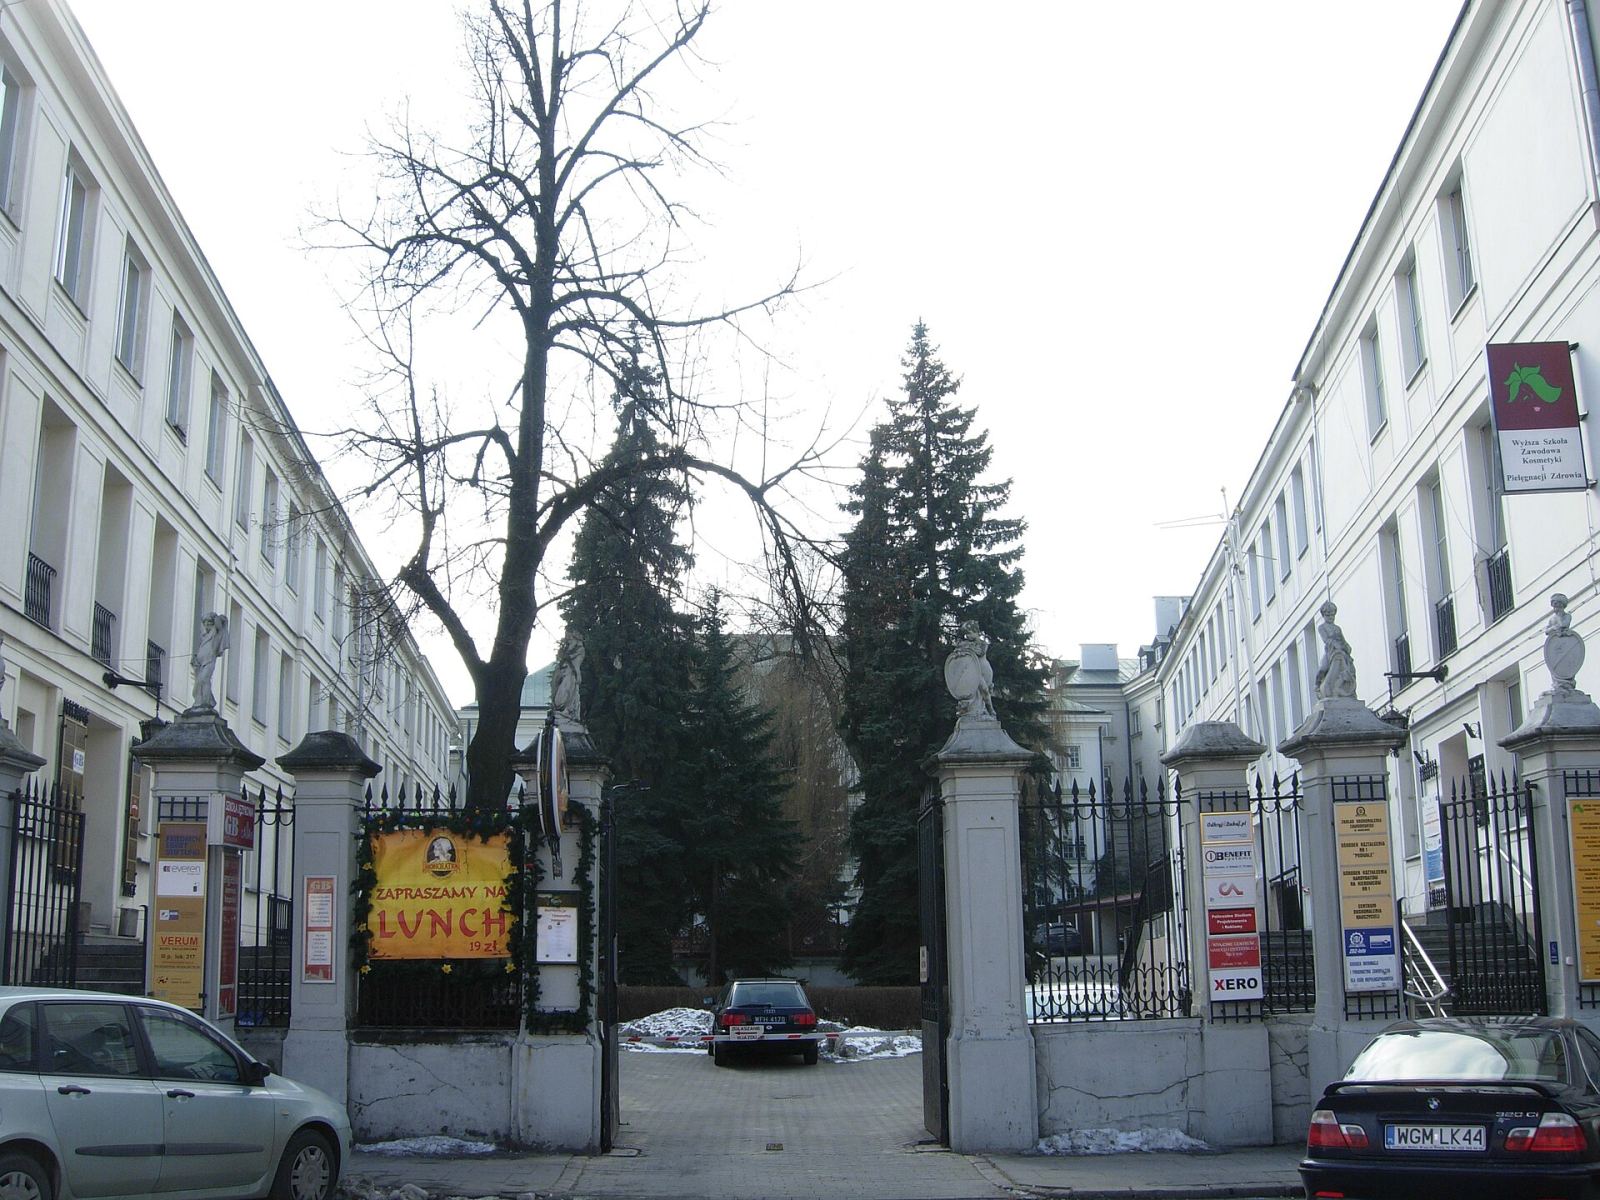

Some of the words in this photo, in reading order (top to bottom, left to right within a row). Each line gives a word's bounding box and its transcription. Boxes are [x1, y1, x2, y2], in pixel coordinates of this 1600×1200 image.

[1512, 439, 1539, 449] Wyższa
[1543, 438, 1568, 446] Szkoła
[1521, 448, 1561, 456] Zawodowa
[1522, 456, 1562, 465] Kosmetyki
[1507, 474, 1547, 483] Pielęgnacji
[1551, 472, 1582, 480] Zdrowia
[225, 814, 239, 837] GB
[1216, 850, 1252, 861] BENEFIT
[310, 880, 331, 890] GB
[376, 886, 478, 900] ZAPRASZAMY
[483, 886, 508, 898] NA
[377, 907, 507, 939] LUNCH
[160, 936, 198, 946] VERUM
[469, 940, 481, 951] 19
[1214, 977, 1258, 992] XERO
[1397, 1128, 1434, 1145] WGM
[1439, 1128, 1483, 1146] LK44
